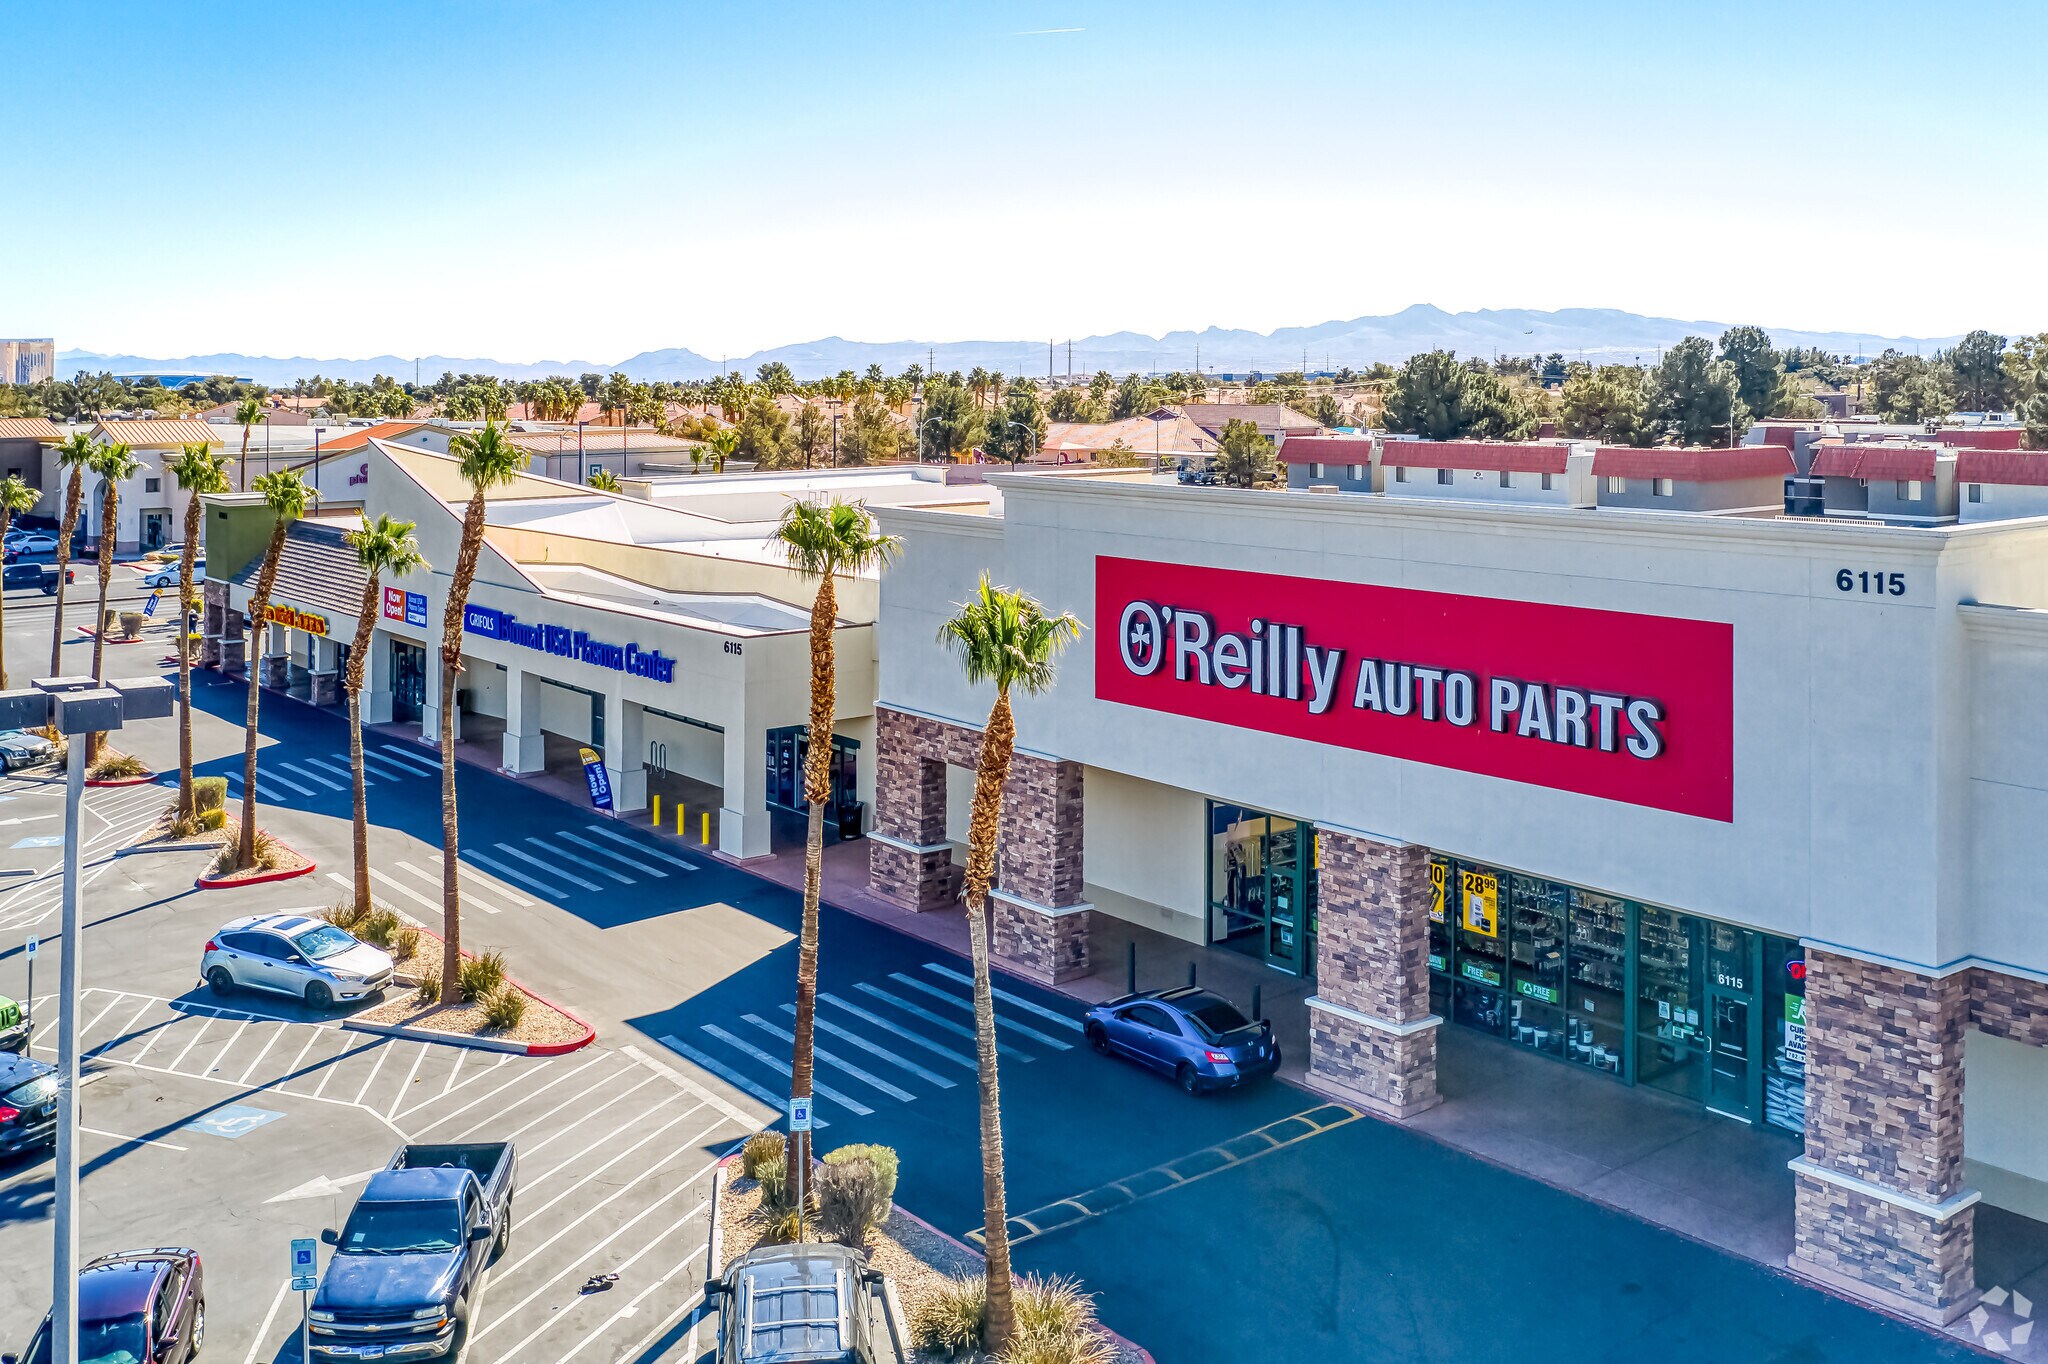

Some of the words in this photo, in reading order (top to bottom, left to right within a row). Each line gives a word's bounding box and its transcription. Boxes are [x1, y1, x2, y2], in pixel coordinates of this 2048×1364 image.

[1836, 568, 1906, 596] 6115
[388, 590, 401, 603] Now
[469, 612, 494, 631] GRIFOLS
[501, 613, 544, 651] Biomat
[544, 624, 573, 658] USA
[573, 630, 625, 671] Plasma
[625, 642, 677, 684] Center
[724, 640, 743, 656] 6115
[1353, 658, 1477, 727] AUTO
[1490, 676, 1666, 760] PARTS
[588, 774, 600, 797] Now
[1467, 965, 1484, 978] FREE
[1718, 974, 1743, 989] 6115
[1533, 984, 1550, 997] FREE
